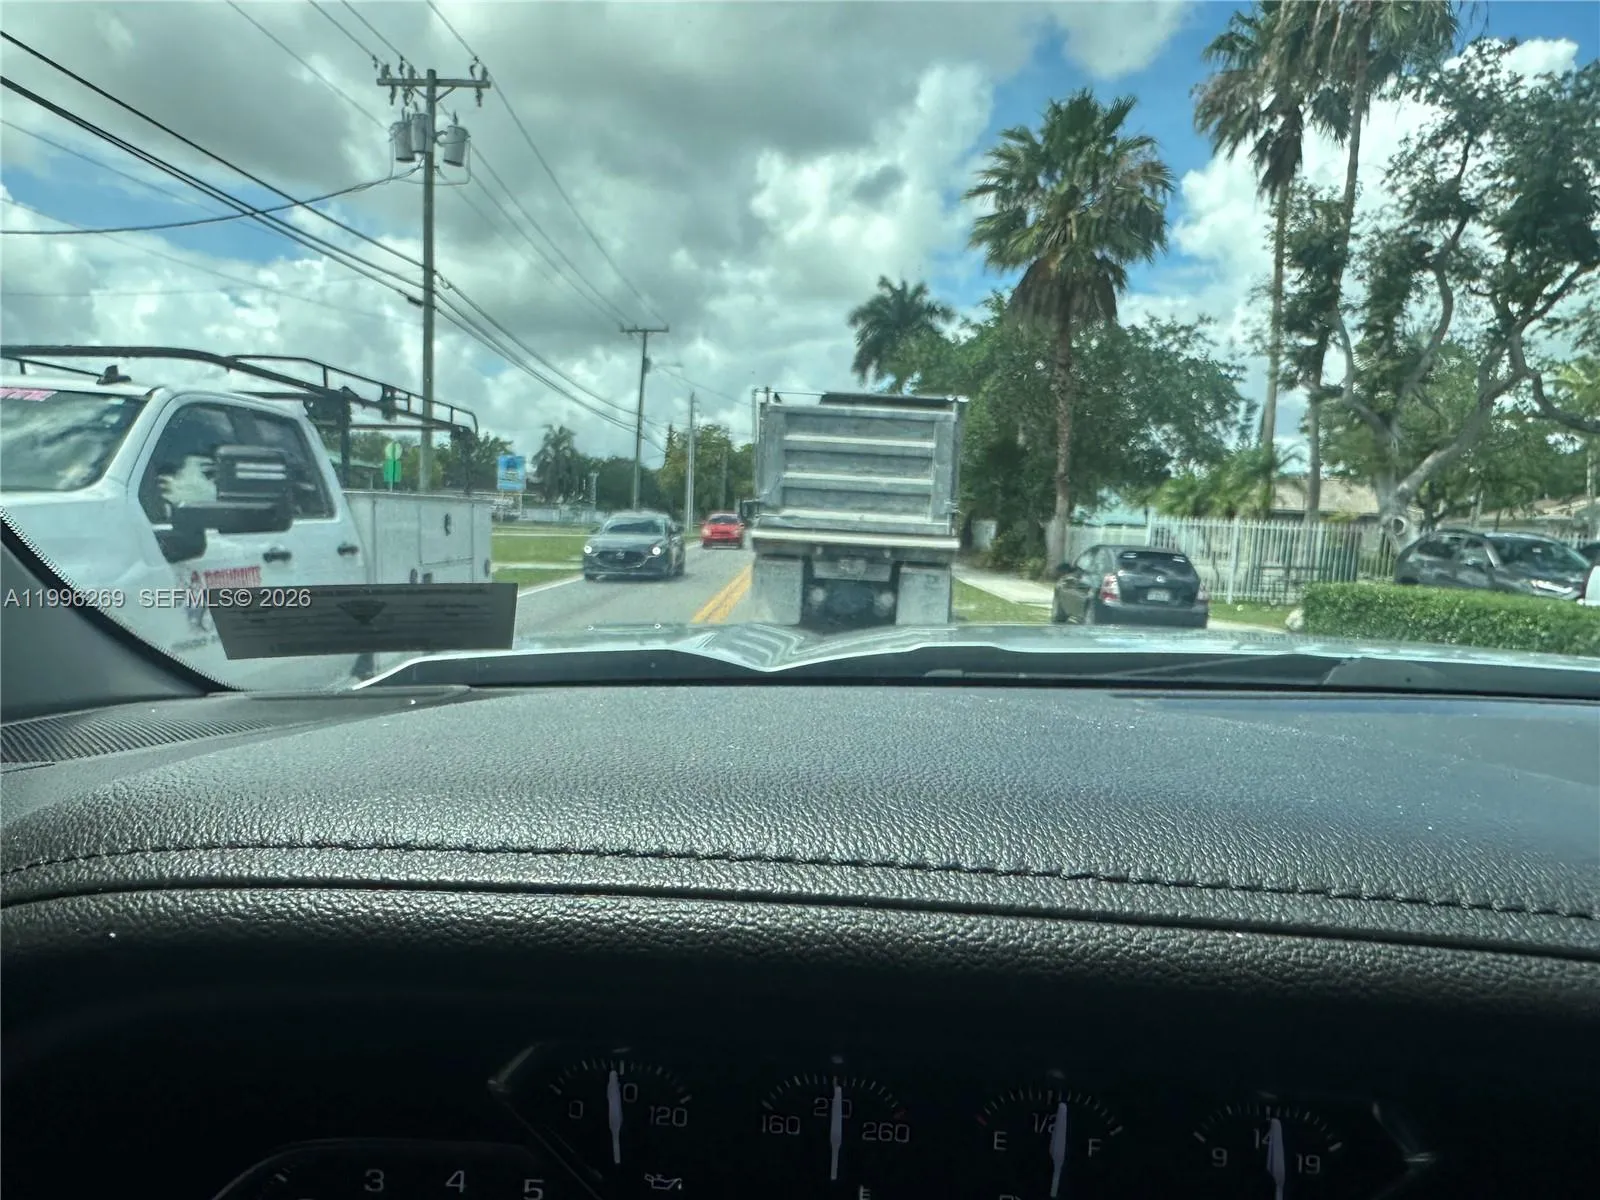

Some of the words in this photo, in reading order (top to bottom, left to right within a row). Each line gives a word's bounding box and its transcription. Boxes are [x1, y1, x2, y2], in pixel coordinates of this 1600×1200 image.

[568, 1100, 584, 1120] 0
[649, 1105, 689, 1128] 120
[761, 1114, 801, 1136] 160
[861, 1120, 910, 1143] 260
[993, 1130, 1008, 1152] E
[1087, 1137, 1102, 1158] F
[1212, 1147, 1228, 1168] 9
[1296, 1152, 1321, 1175] 19
[364, 1168, 385, 1193] 3
[445, 1169, 467, 1194] 4
[523, 1178, 545, 1200] 5
